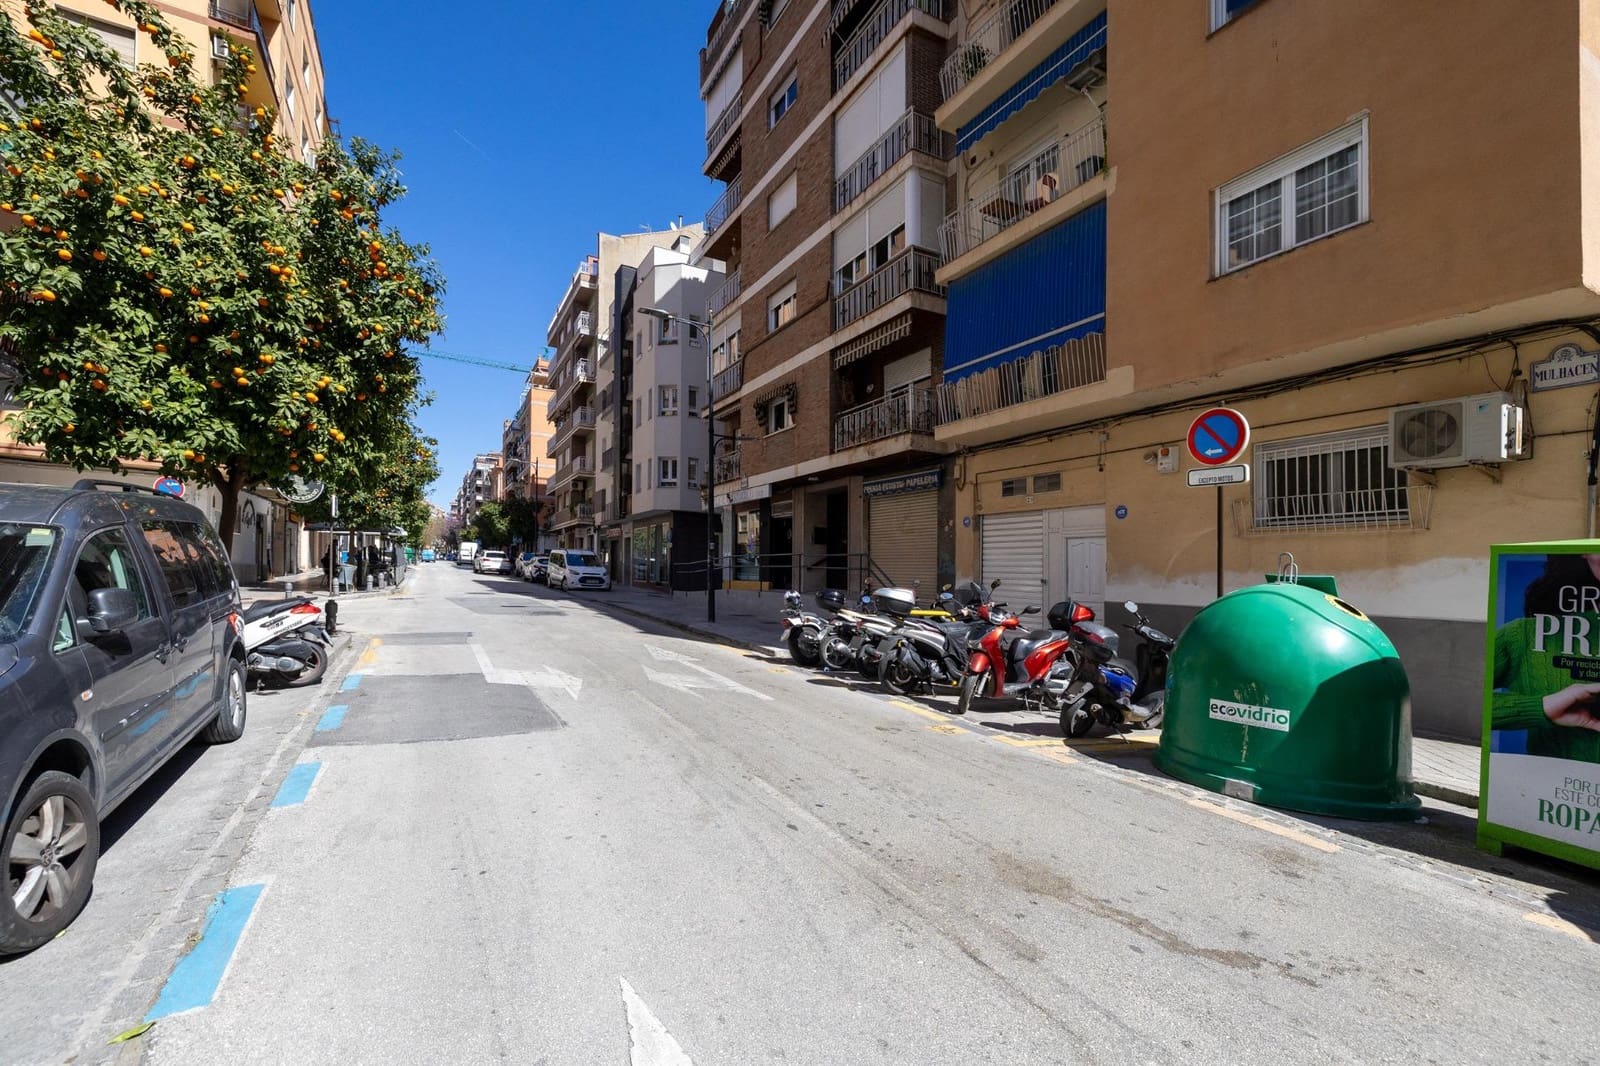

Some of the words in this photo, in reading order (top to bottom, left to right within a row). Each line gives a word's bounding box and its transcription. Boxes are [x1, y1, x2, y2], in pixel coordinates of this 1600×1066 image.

[1535, 363, 1599, 381] MULHACEN
[1559, 585, 1600, 614] GR
[1531, 613, 1600, 657] PR
[1560, 657, 1573, 667] Por
[1211, 703, 1288, 725] ecovidrio
[1564, 777, 1591, 793] POR
[1554, 787, 1584, 805] ESTE
[1538, 798, 1600, 834] ROPA
